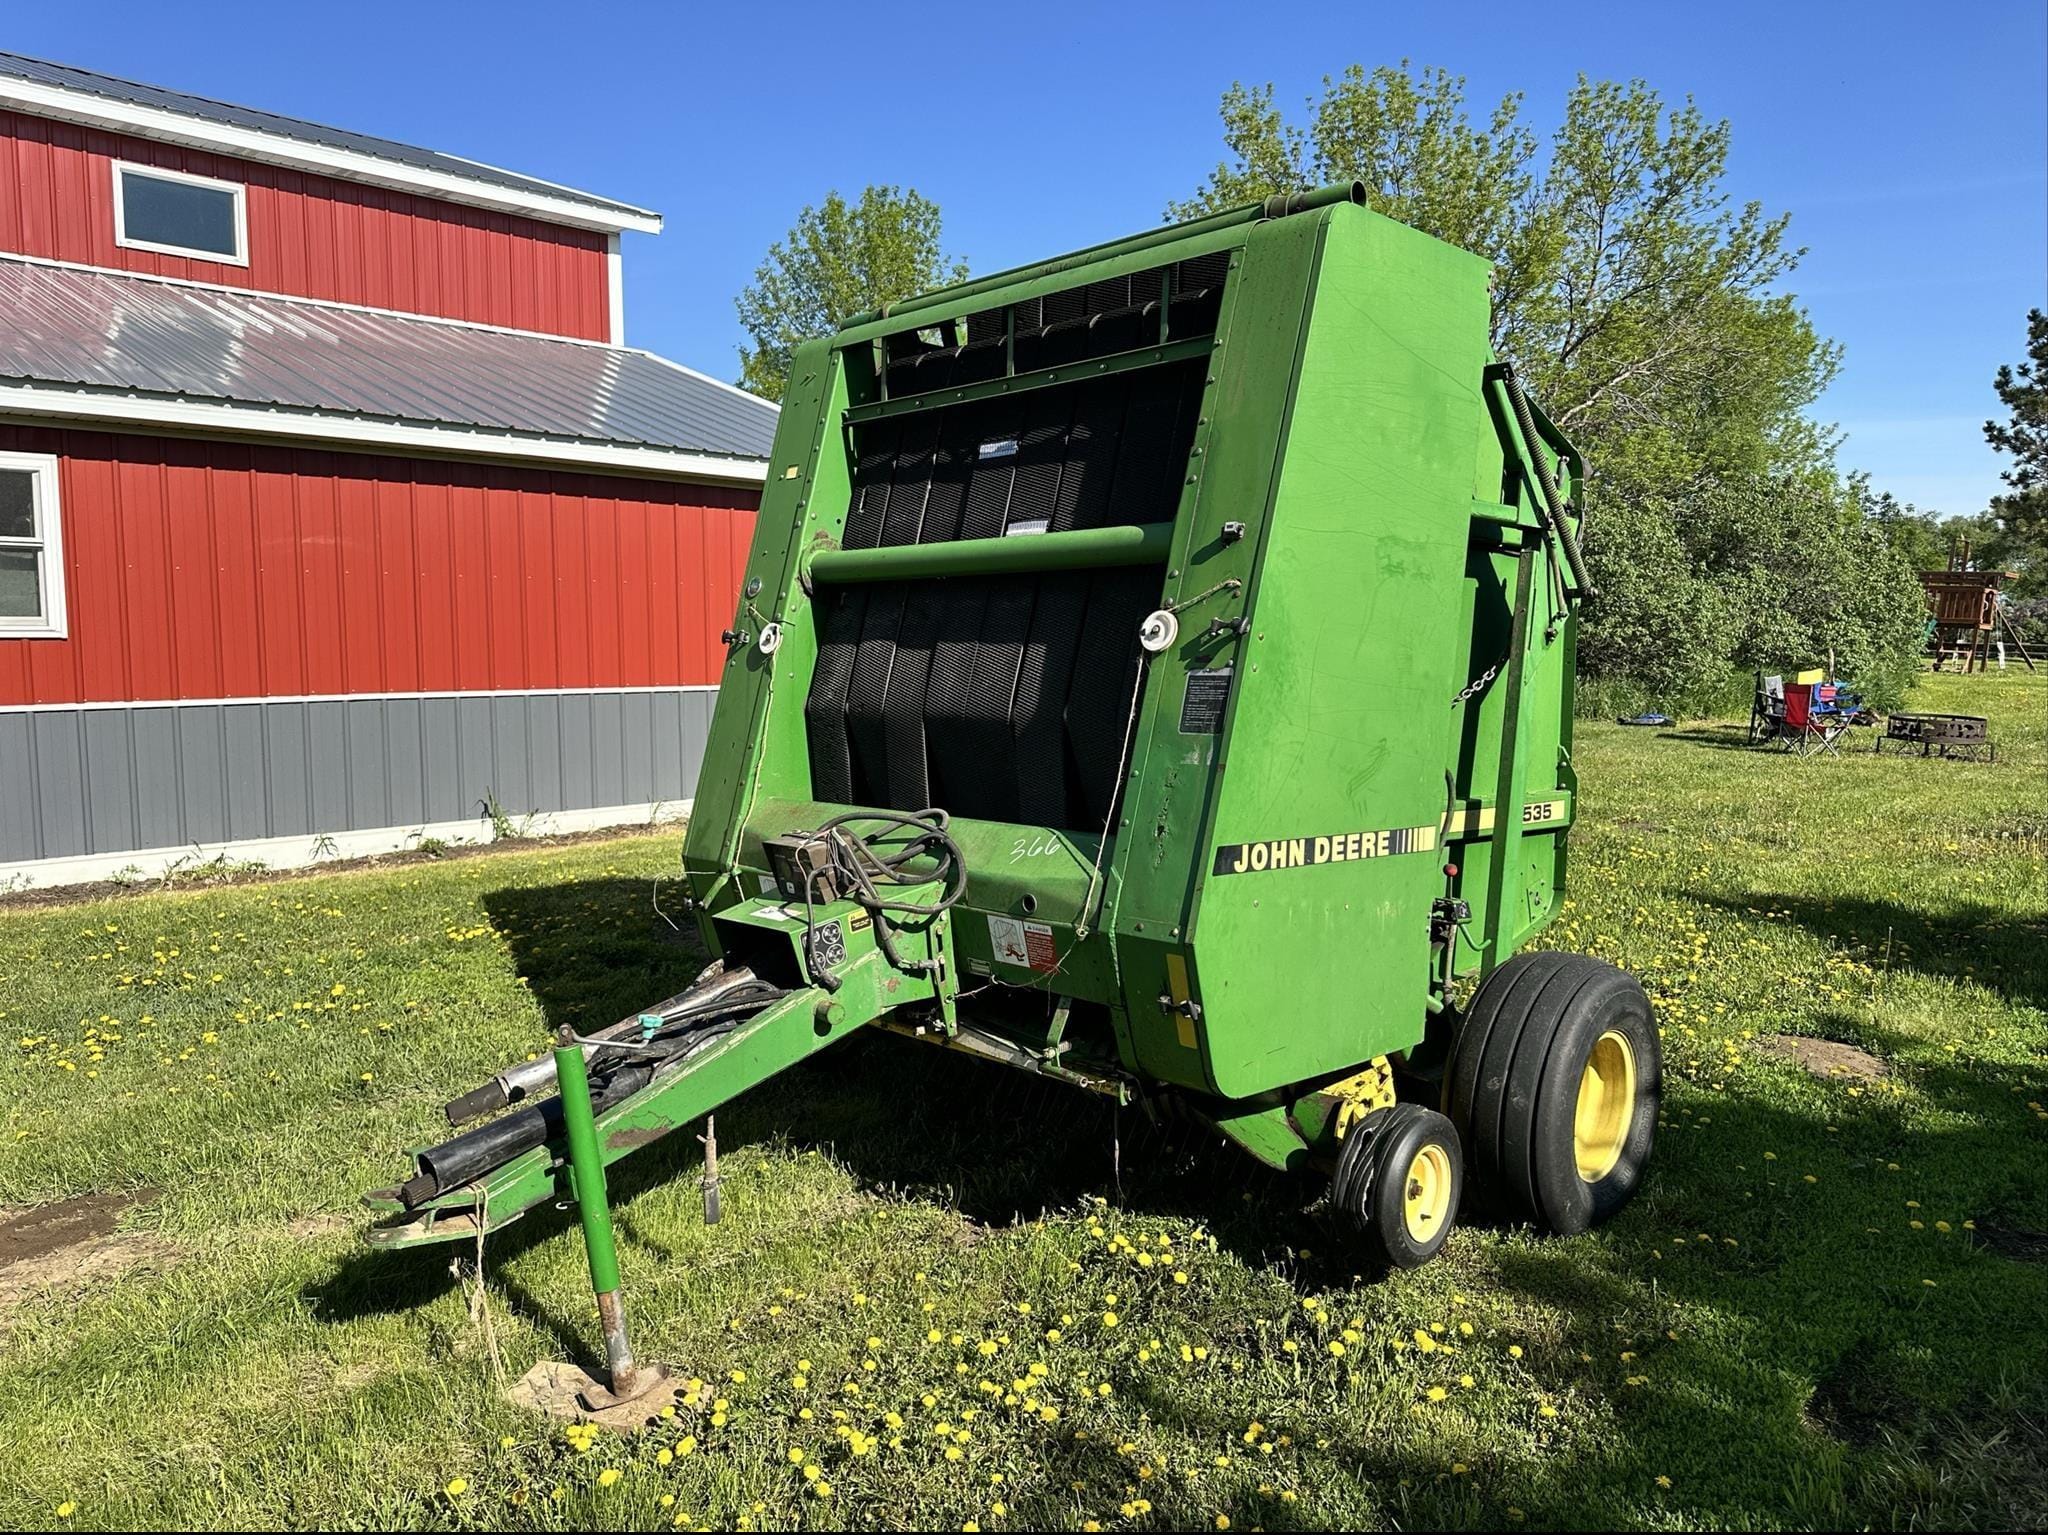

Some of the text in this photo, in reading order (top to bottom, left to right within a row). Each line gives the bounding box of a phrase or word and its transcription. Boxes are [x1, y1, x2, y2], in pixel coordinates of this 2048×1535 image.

[1523, 803, 1552, 822] 535
[1008, 835, 1061, 865] 366
[1233, 830, 1391, 874] JOHN DEERE
